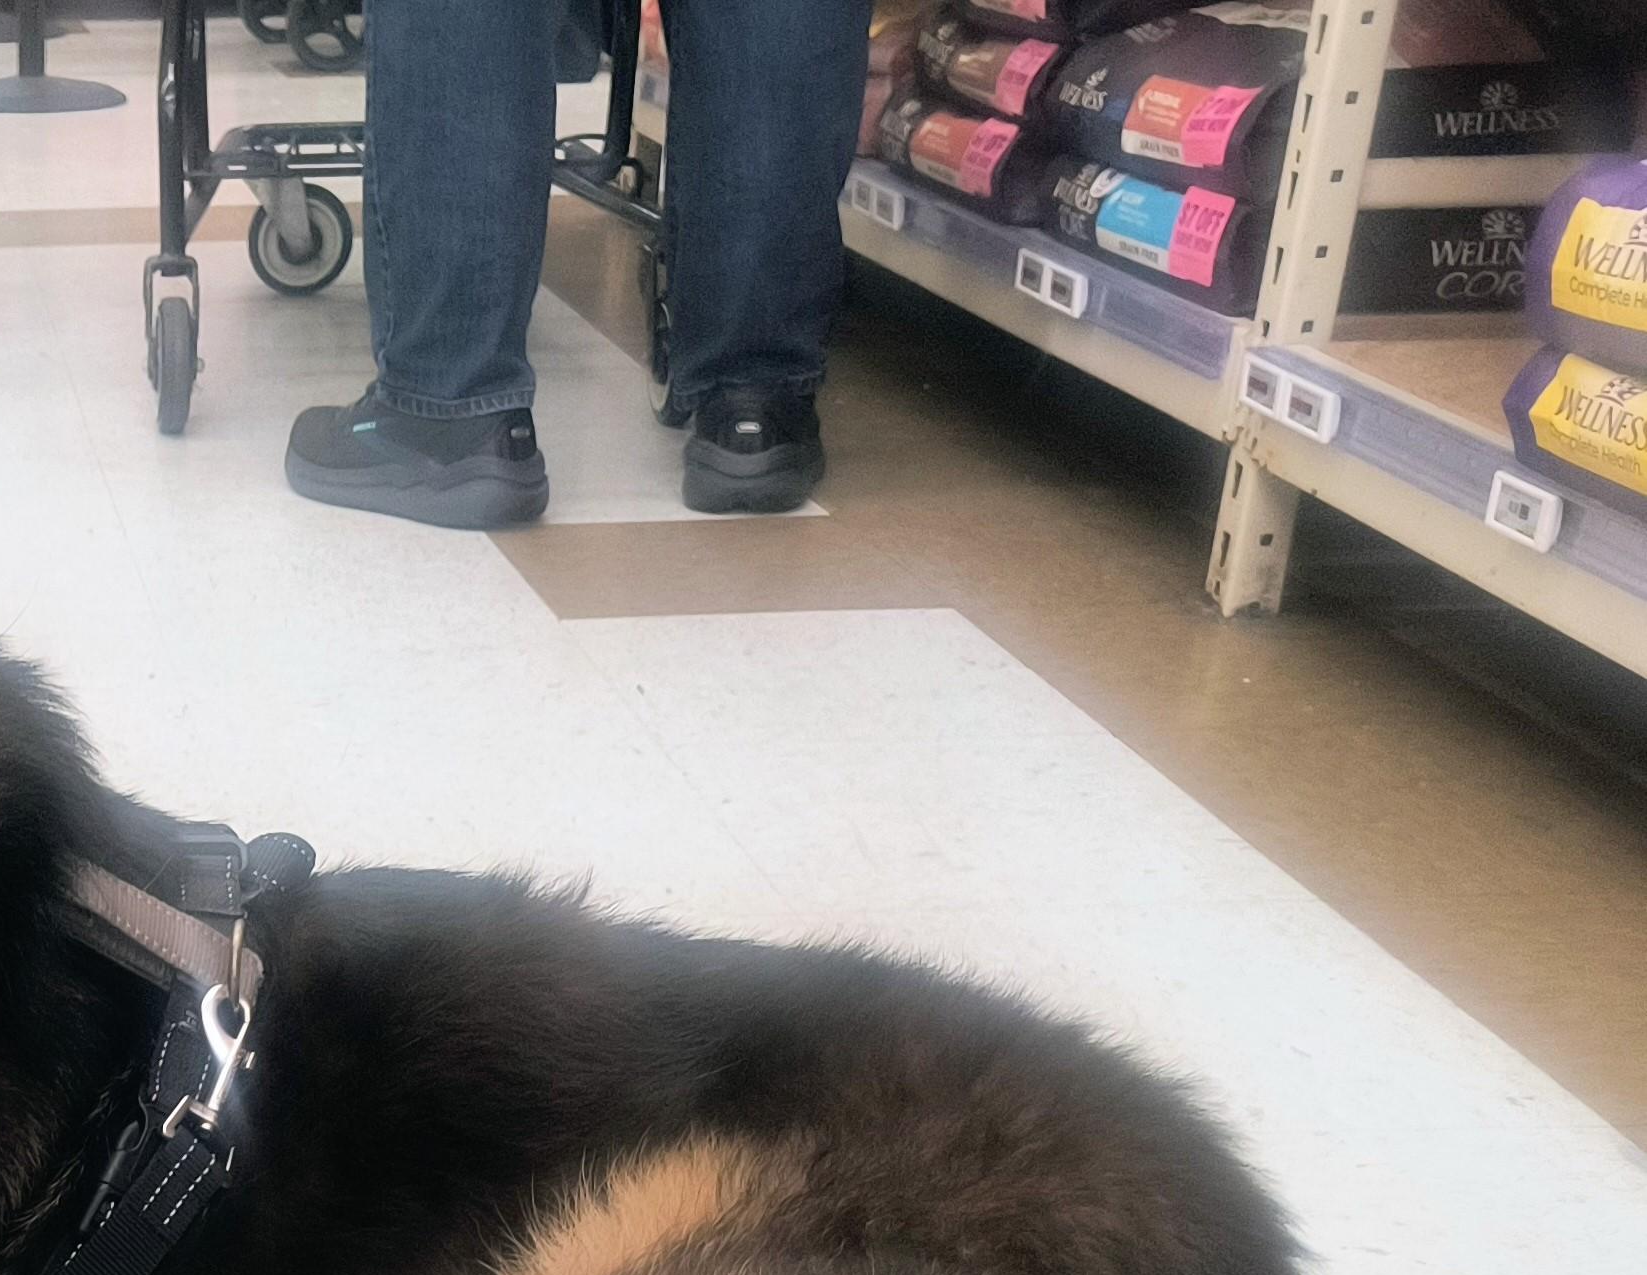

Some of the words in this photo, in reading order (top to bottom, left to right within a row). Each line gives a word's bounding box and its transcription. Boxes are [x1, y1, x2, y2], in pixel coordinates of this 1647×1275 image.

[1435, 105, 1560, 137] WELLNESS
[1431, 240, 1528, 267] WELLN
[1574, 234, 1647, 283] WELLN
[1436, 270, 1525, 300] COR
[1570, 276, 1631, 307] Complete
